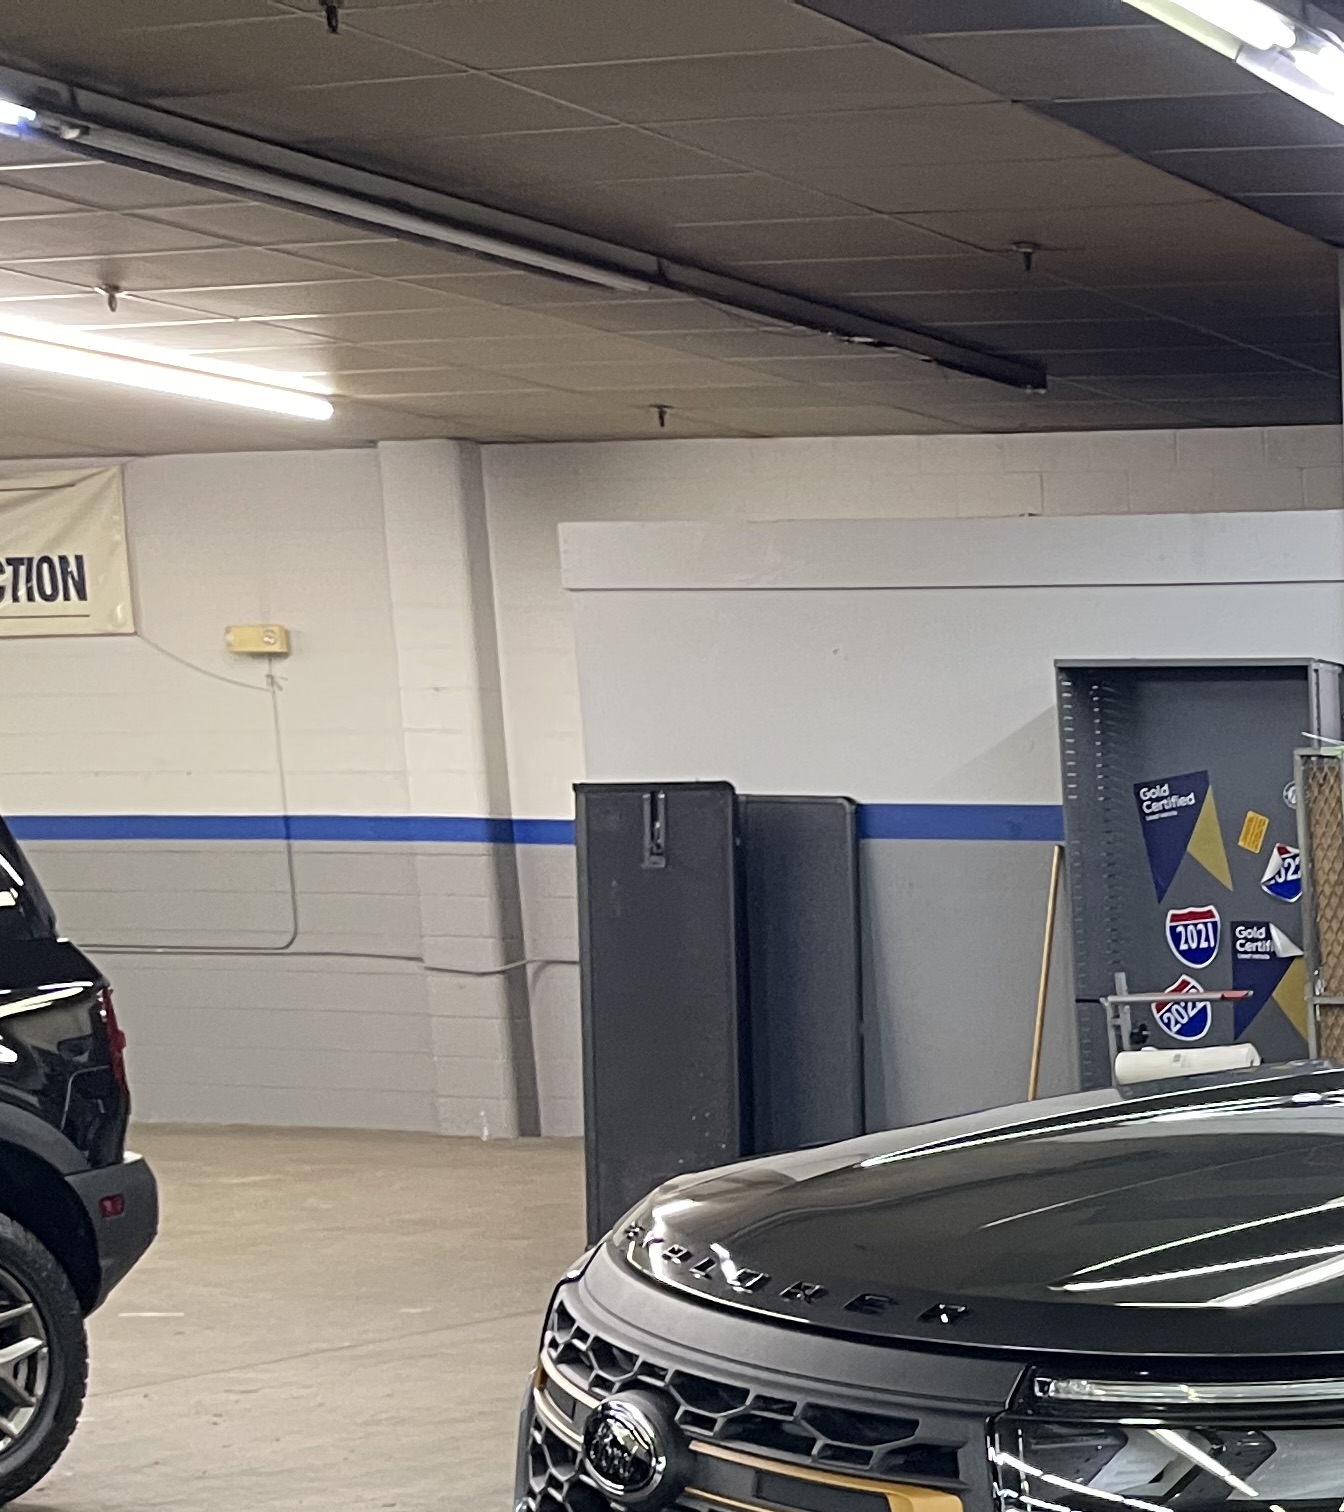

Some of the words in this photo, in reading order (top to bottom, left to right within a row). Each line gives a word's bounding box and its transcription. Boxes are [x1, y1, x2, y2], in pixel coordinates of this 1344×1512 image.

[0, 555, 88, 603] TION
[1139, 783, 1170, 800] Gold
[1142, 792, 1196, 814] Certified
[1176, 922, 1215, 951] 2021
[1235, 926, 1266, 939] Gold
